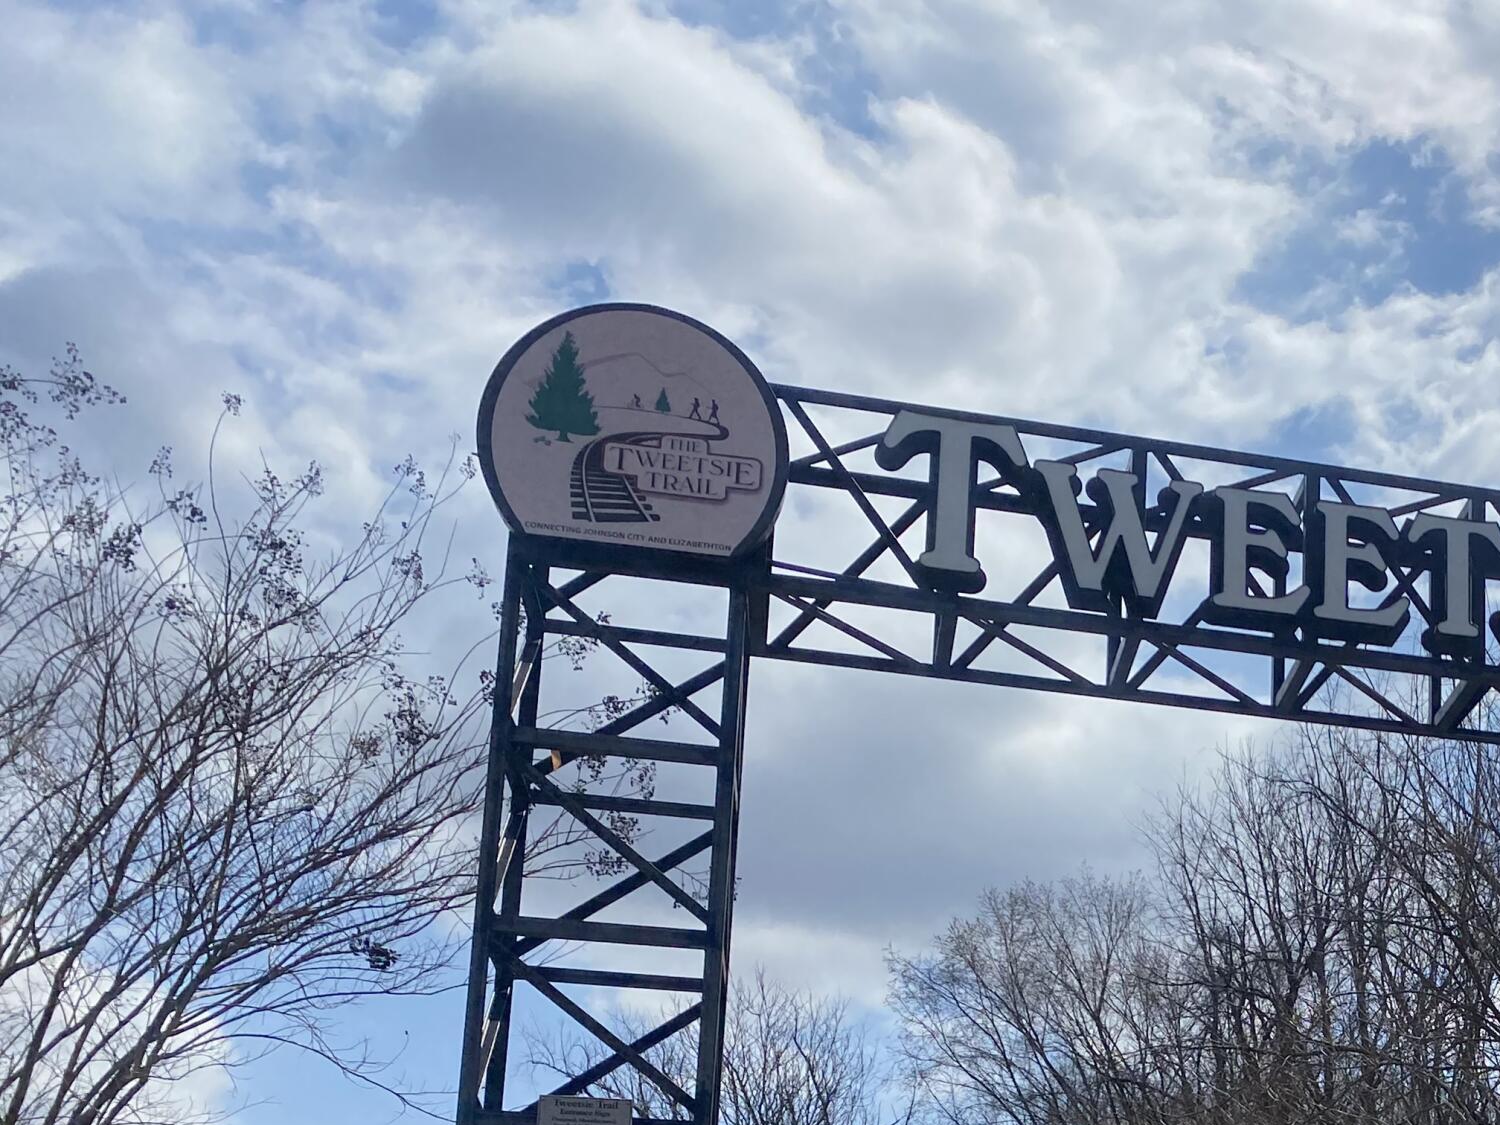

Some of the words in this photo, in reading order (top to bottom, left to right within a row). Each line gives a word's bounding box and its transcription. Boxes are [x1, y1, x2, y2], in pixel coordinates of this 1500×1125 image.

[666, 438, 701, 453] THE
[609, 446, 756, 487] TWEETSIE
[645, 471, 718, 496] TRAIL
[524, 520, 582, 535] CONNECTING
[583, 528, 626, 540] JOHNSON
[627, 532, 646, 542] CITY
[647, 535, 667, 545] AND
